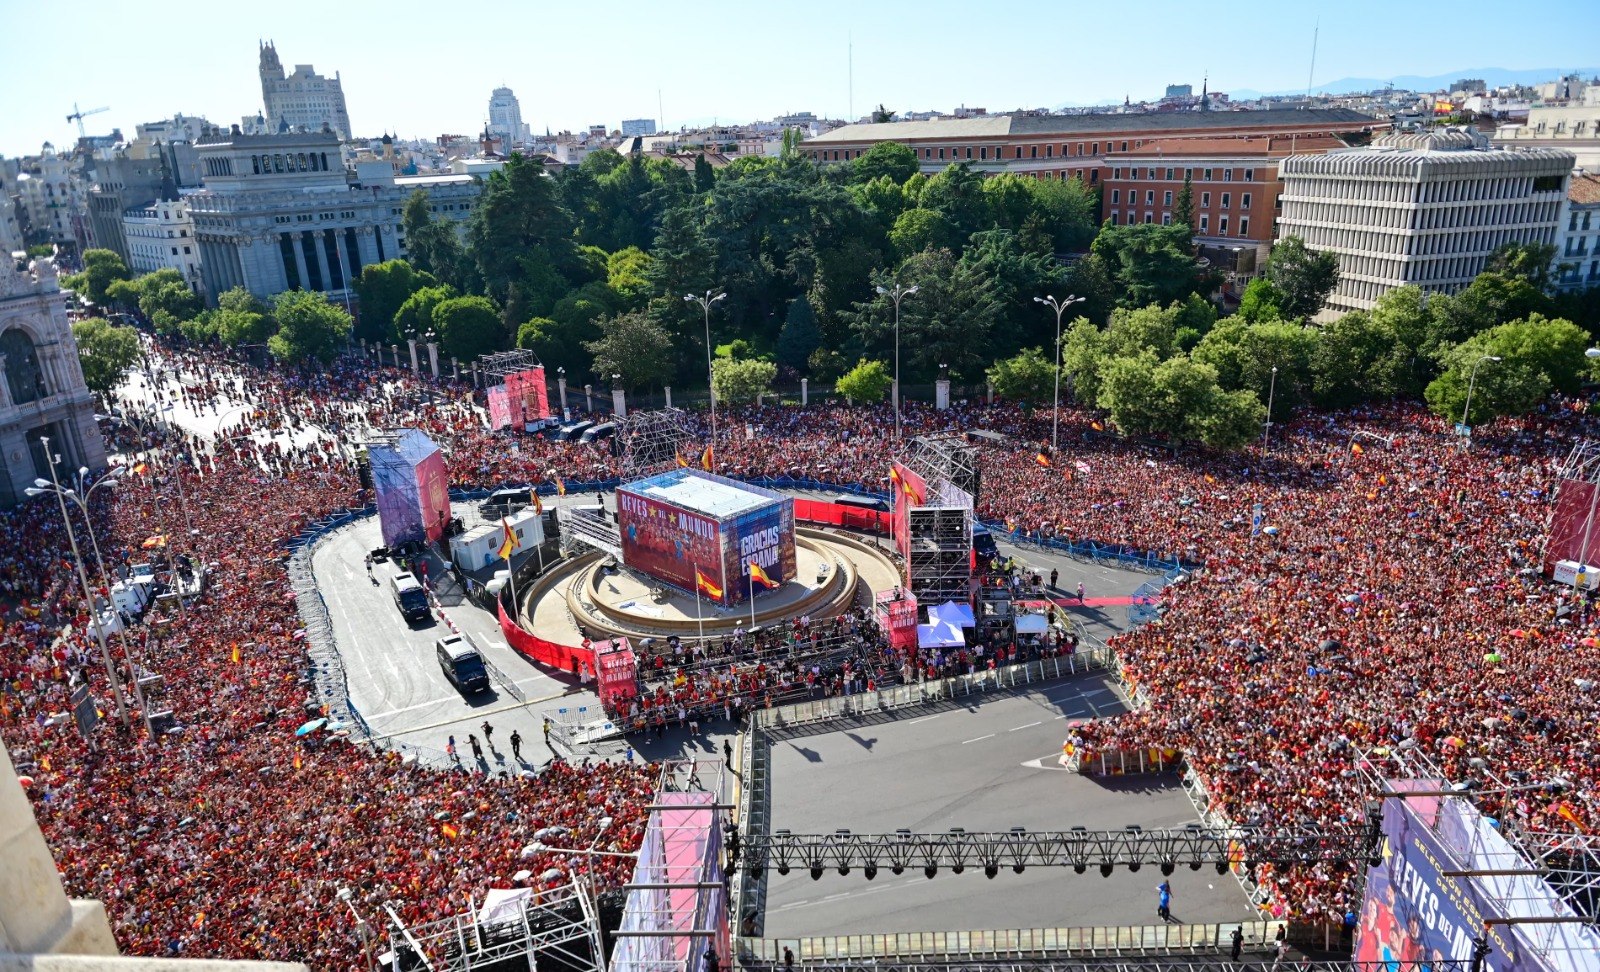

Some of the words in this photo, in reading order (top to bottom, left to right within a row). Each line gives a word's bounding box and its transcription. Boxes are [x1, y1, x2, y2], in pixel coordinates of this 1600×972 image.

[621, 493, 648, 518] REYES
[678, 512, 714, 540] MUNDO
[606, 670, 632, 682] MUNDO
[1393, 850, 1439, 930] REYES
[1437, 912, 1454, 944] DEL
[1414, 838, 1462, 897] SELECCIÓN
[1436, 876, 1449, 895] DE
[1449, 893, 1485, 941] FÚTBOL
